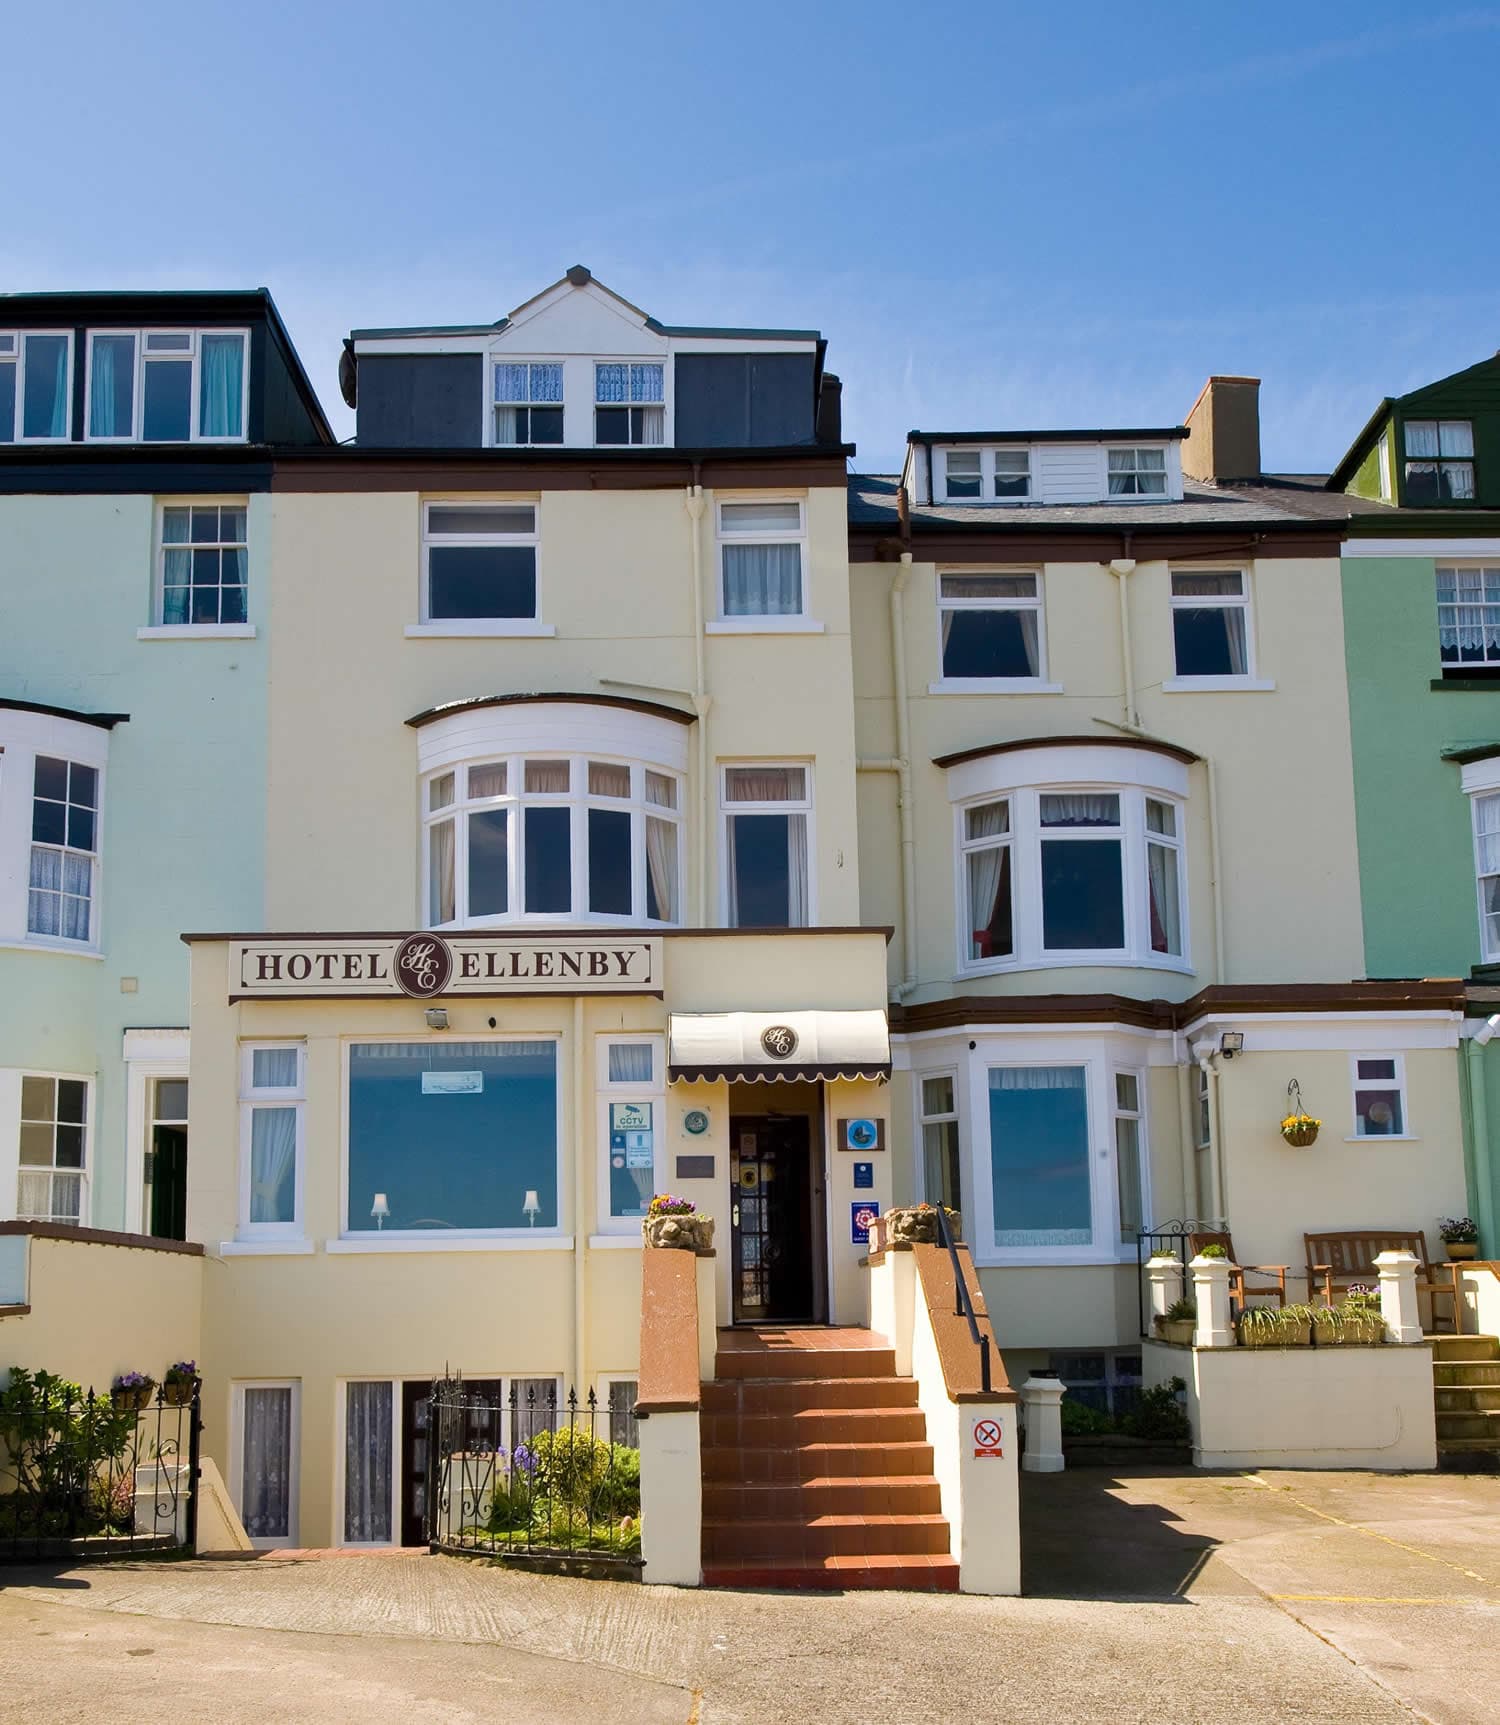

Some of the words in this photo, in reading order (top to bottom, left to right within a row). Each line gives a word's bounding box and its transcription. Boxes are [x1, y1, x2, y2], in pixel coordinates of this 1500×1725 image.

[255, 953, 388, 980] HOTEL
[459, 951, 637, 978] ELLENBY
[619, 1117, 644, 1125] CCTV
